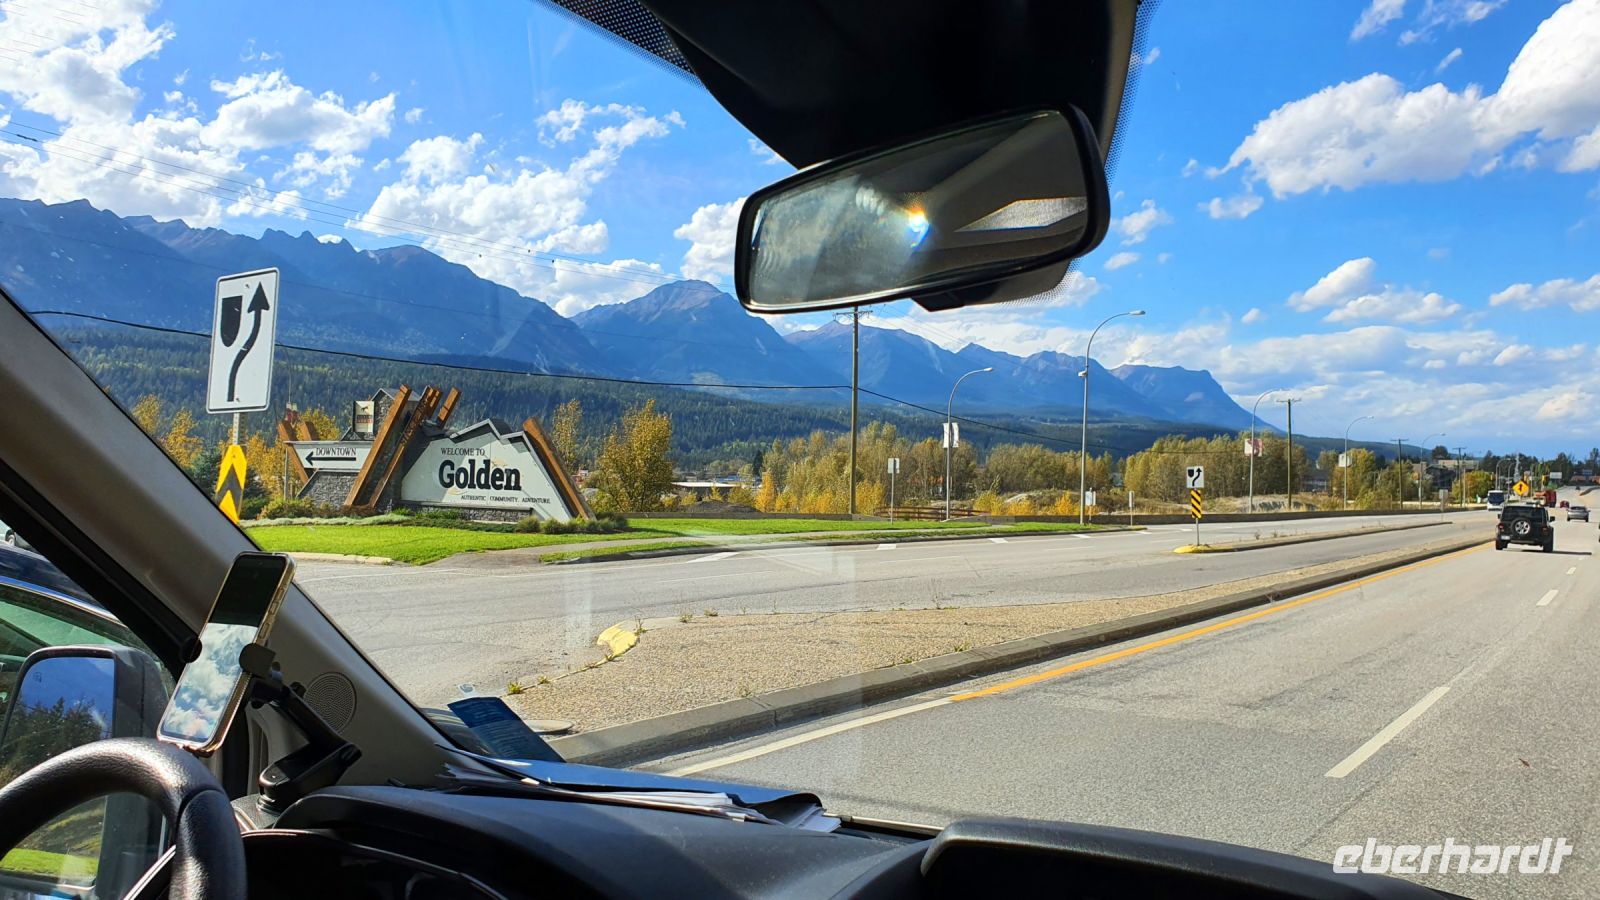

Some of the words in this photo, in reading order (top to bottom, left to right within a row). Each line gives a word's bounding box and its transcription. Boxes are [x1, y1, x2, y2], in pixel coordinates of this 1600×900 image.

[316, 447, 357, 456] DOWNTOWN
[441, 447, 474, 456] WELCOME
[476, 448, 485, 456] TO
[438, 459, 522, 490] Golden
